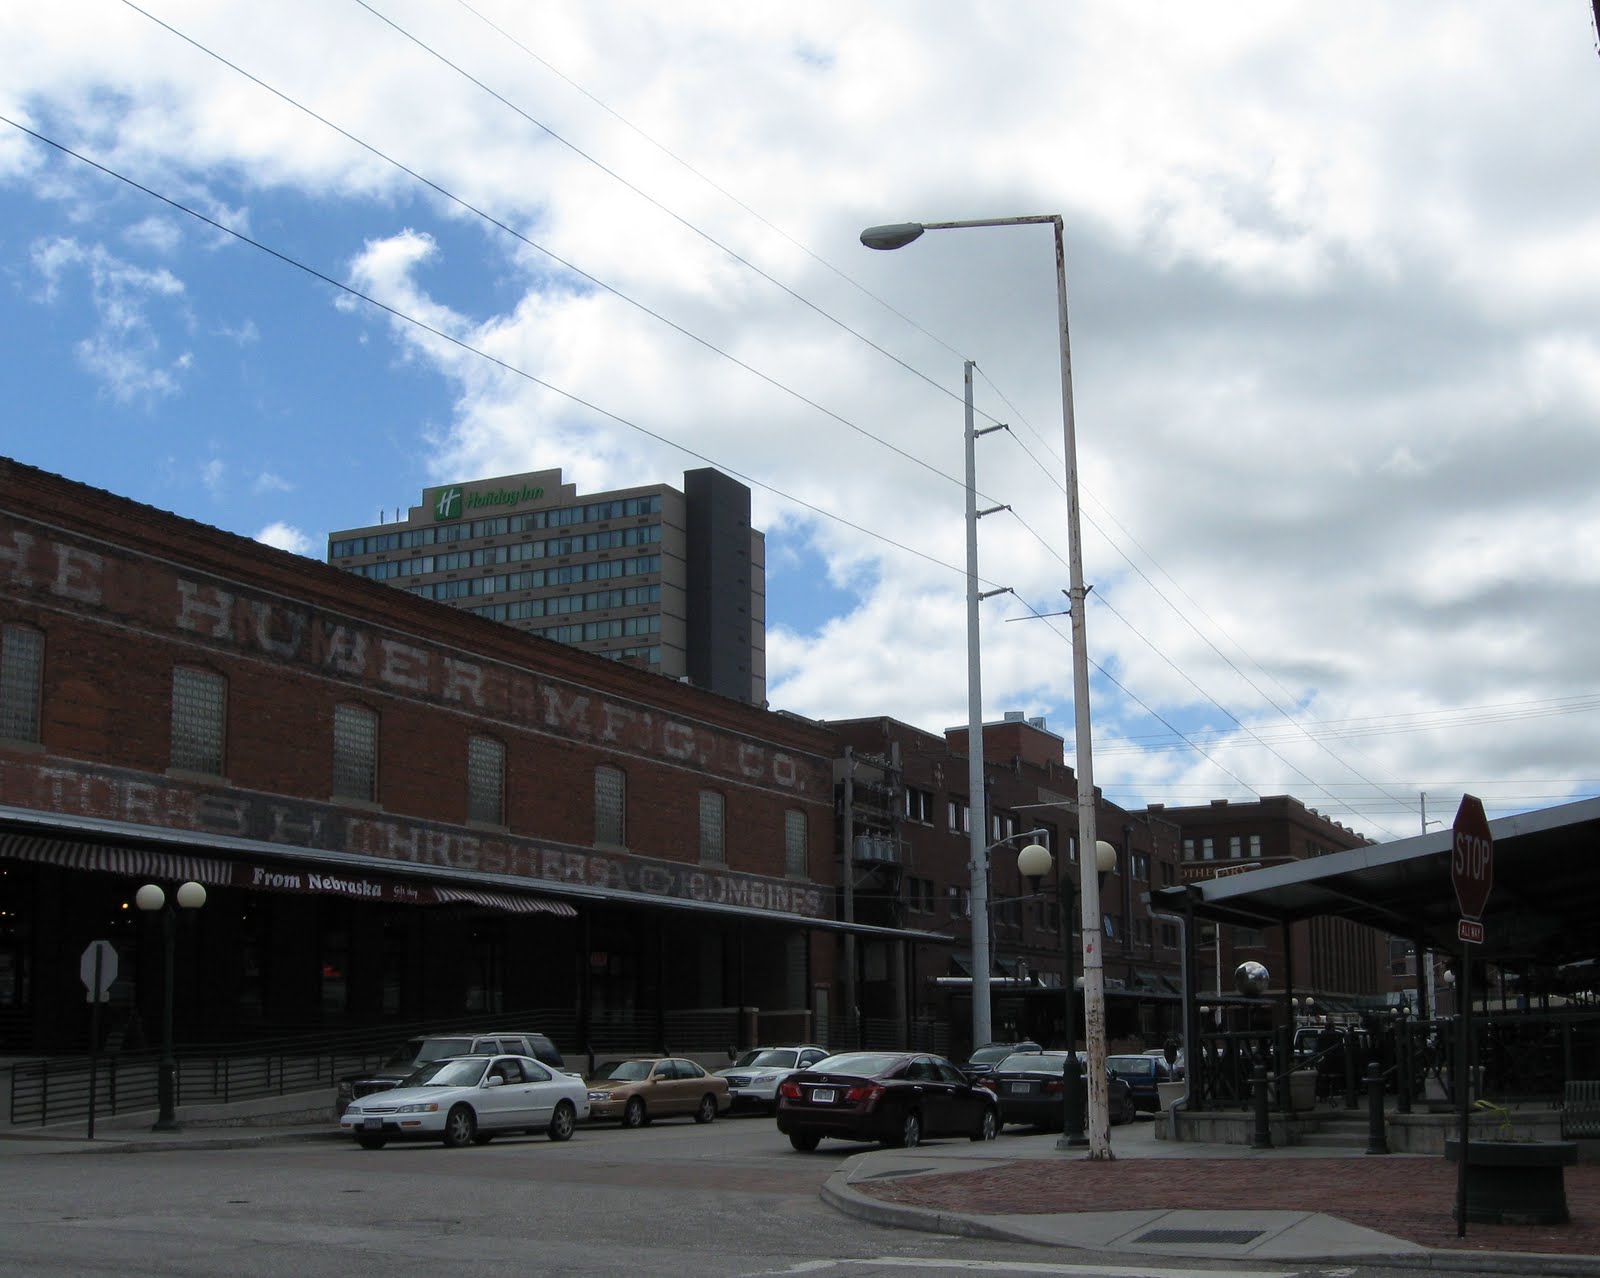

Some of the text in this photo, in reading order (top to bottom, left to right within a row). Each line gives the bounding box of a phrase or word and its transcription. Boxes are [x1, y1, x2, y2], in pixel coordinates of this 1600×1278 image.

[466, 484, 544, 508] Holiday Inn
[1456, 832, 1490, 880] STOP
[252, 867, 382, 897] From Nebraska
